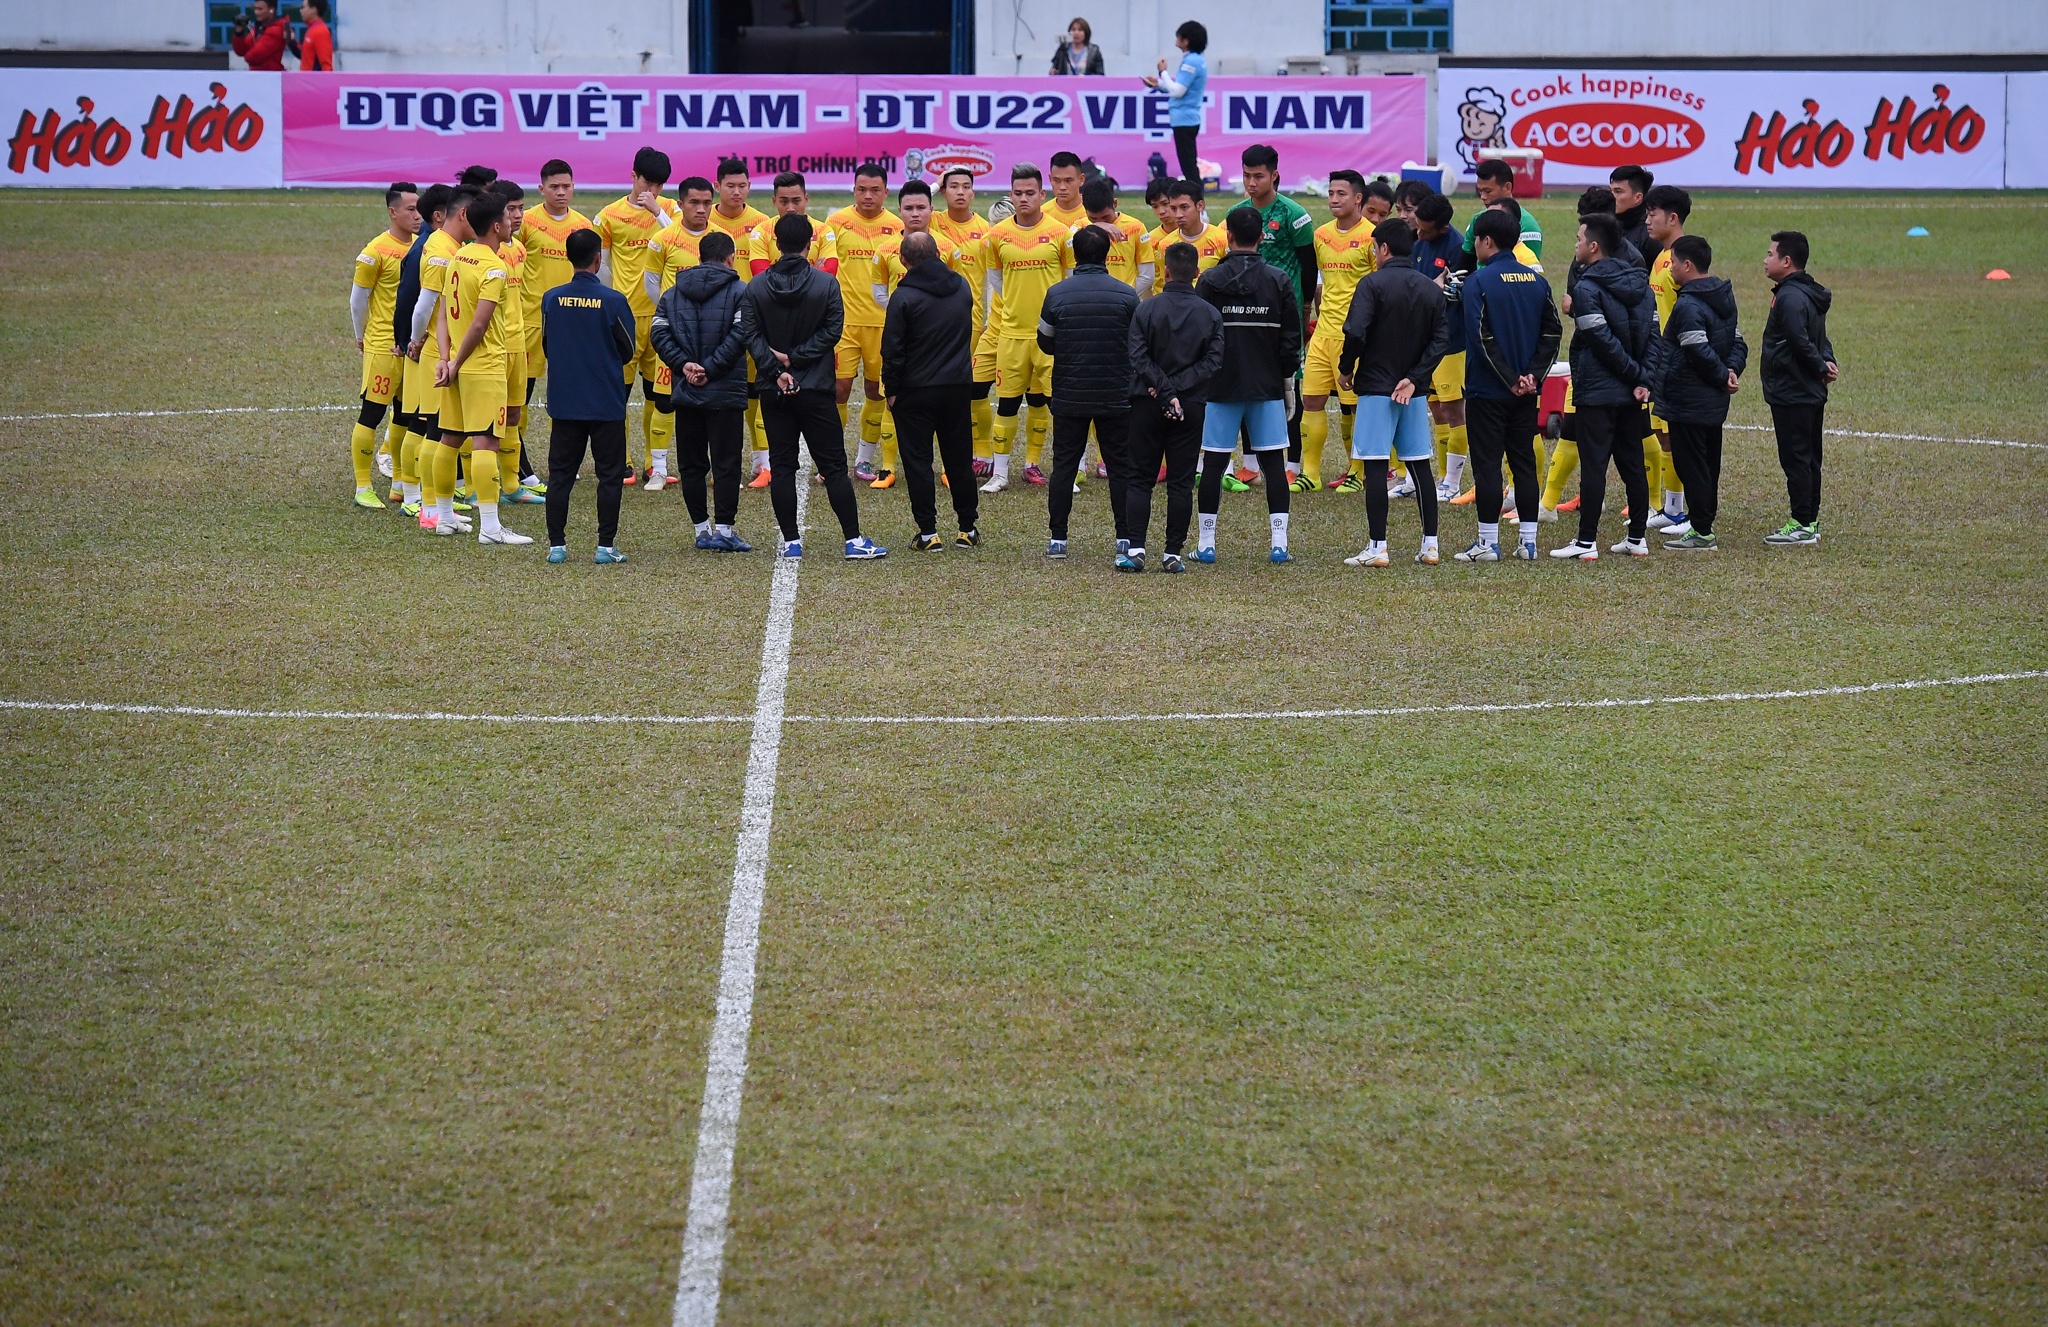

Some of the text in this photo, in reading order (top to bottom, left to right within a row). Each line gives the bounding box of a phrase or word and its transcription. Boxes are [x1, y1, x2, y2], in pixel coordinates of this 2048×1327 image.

[1511, 73, 1706, 111] Cook happiness
[343, 91, 498, 131] ĐTQG
[518, 86, 642, 135] VIỆT
[664, 94, 799, 129] NAM
[863, 95, 935, 129] ĐT
[956, 95, 1064, 129] U22
[1085, 88, 1207, 137] VIỆ
[1229, 96, 1364, 129] NAM
[8, 82, 264, 173] Hảo Hảo
[1734, 84, 1985, 175] Hảo Hảo
[798, 152, 857, 173] CHÍNH
[1008, 259, 1048, 268] HONDA
[1500, 273, 1537, 282] VIETNAM
[450, 270, 461, 320] 3
[558, 296, 602, 308] VIETNAM
[1245, 306, 1269, 315] SPORT
[372, 375, 391, 395] 33
[656, 366, 672, 386] 28
[497, 406, 506, 426] 3
